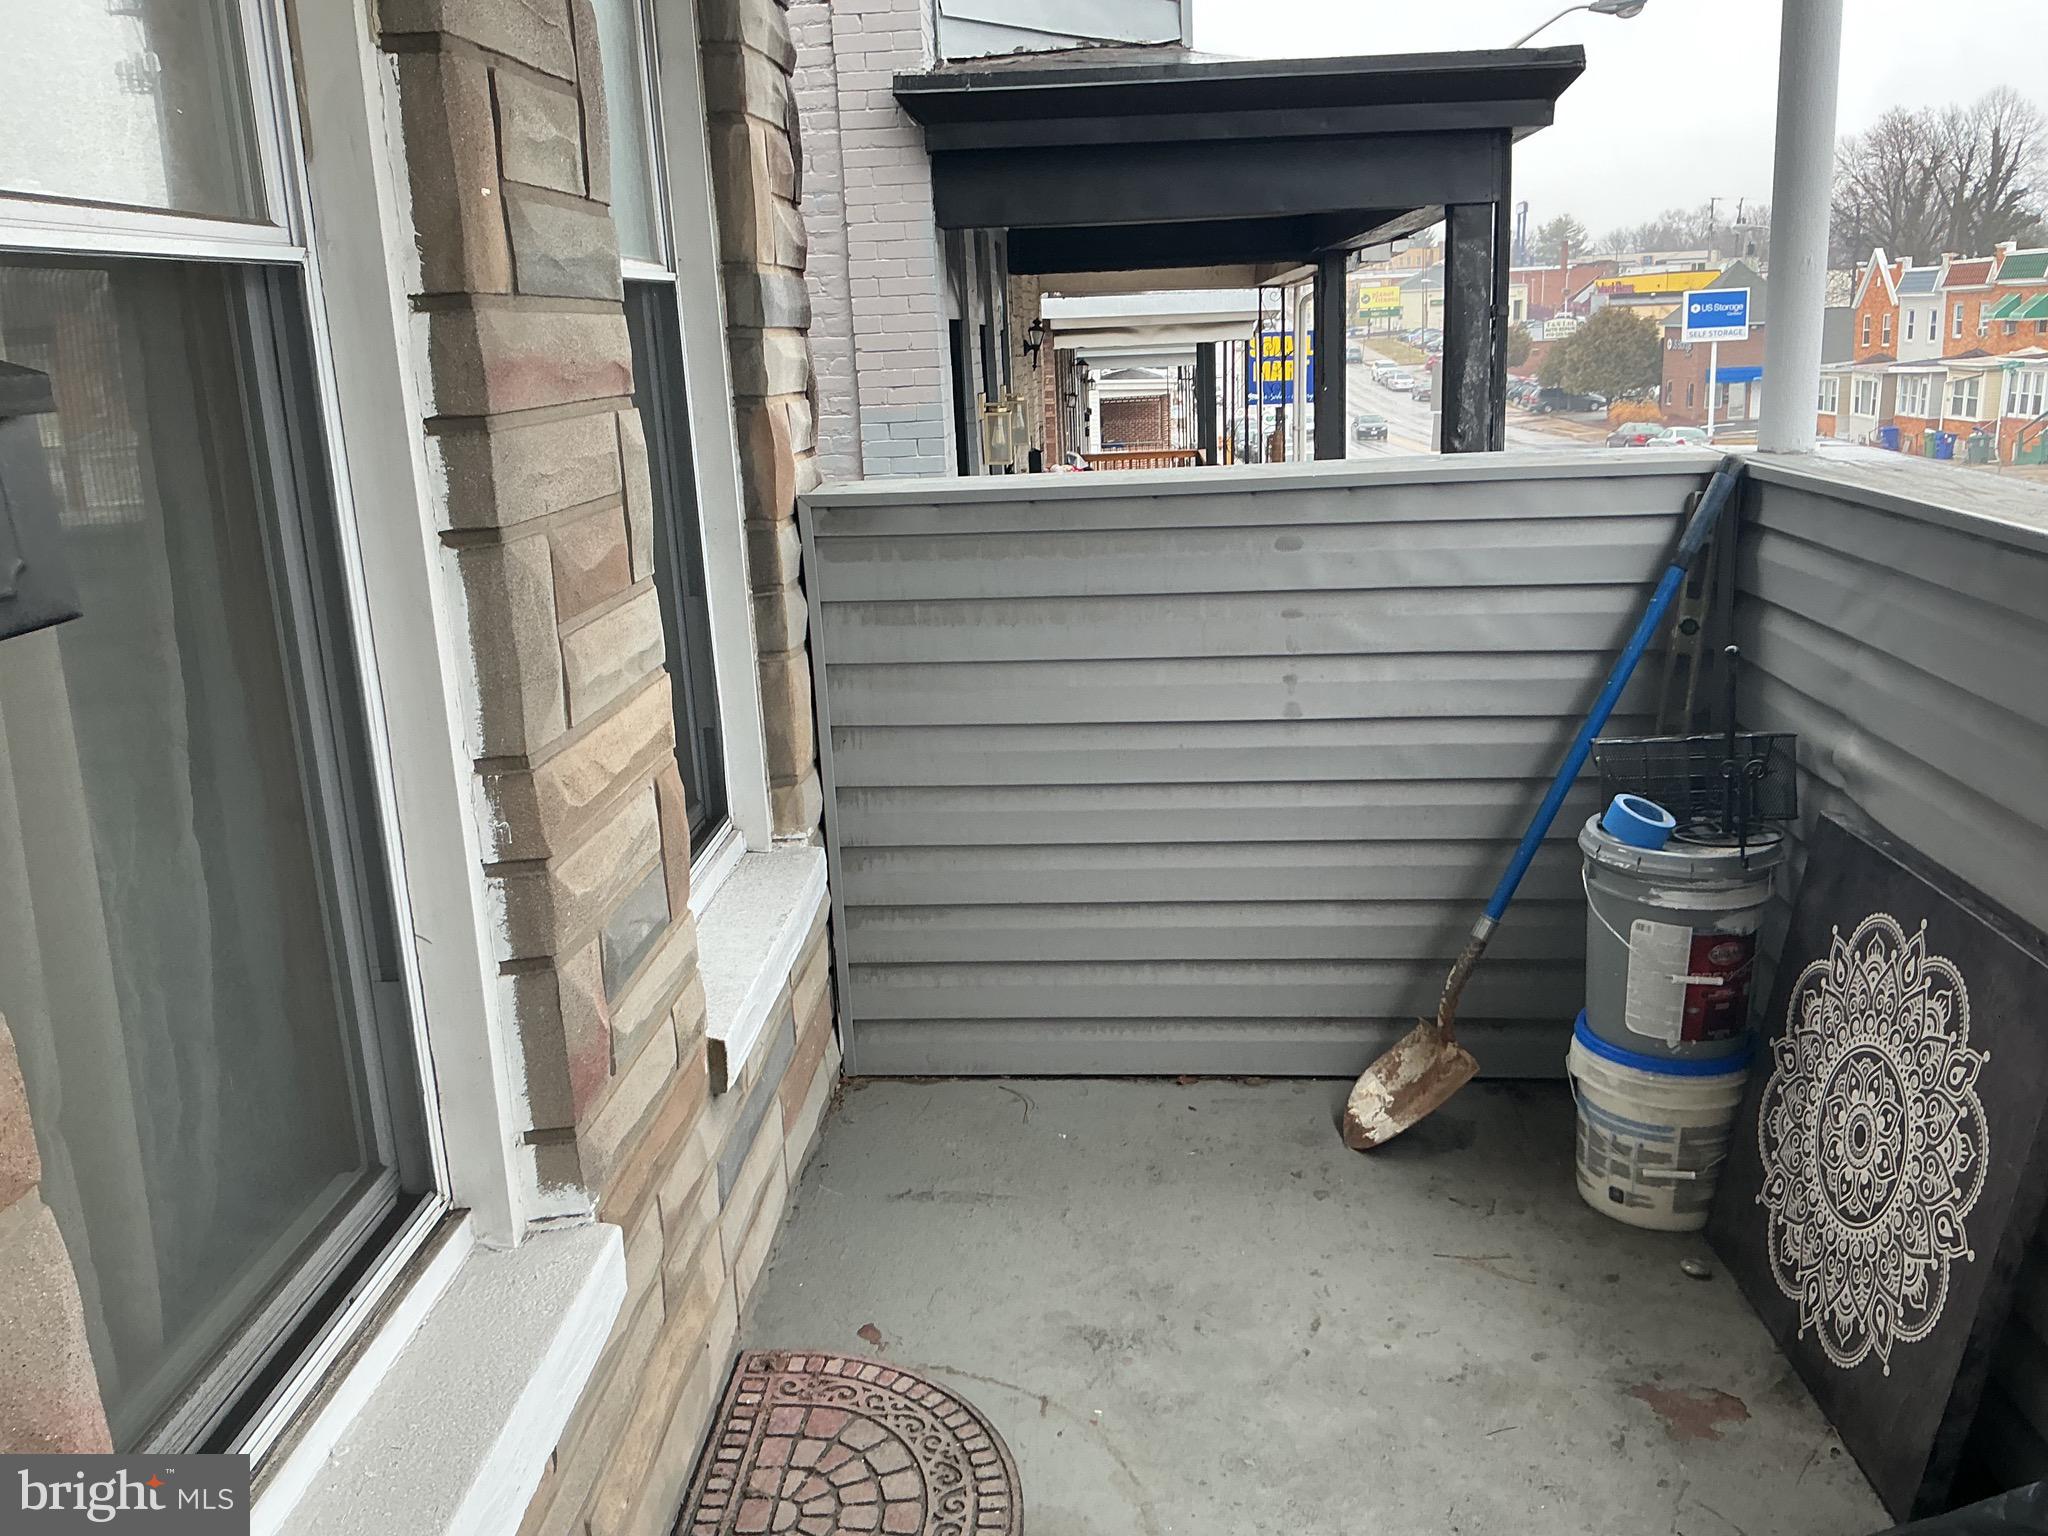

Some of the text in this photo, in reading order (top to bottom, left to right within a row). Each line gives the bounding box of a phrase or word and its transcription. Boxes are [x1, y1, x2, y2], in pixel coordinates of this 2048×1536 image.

[1701, 303, 1744, 313] US Storage
[1688, 328, 1744, 338] SELF STORAGE
[1253, 359, 1311, 382] MAR
